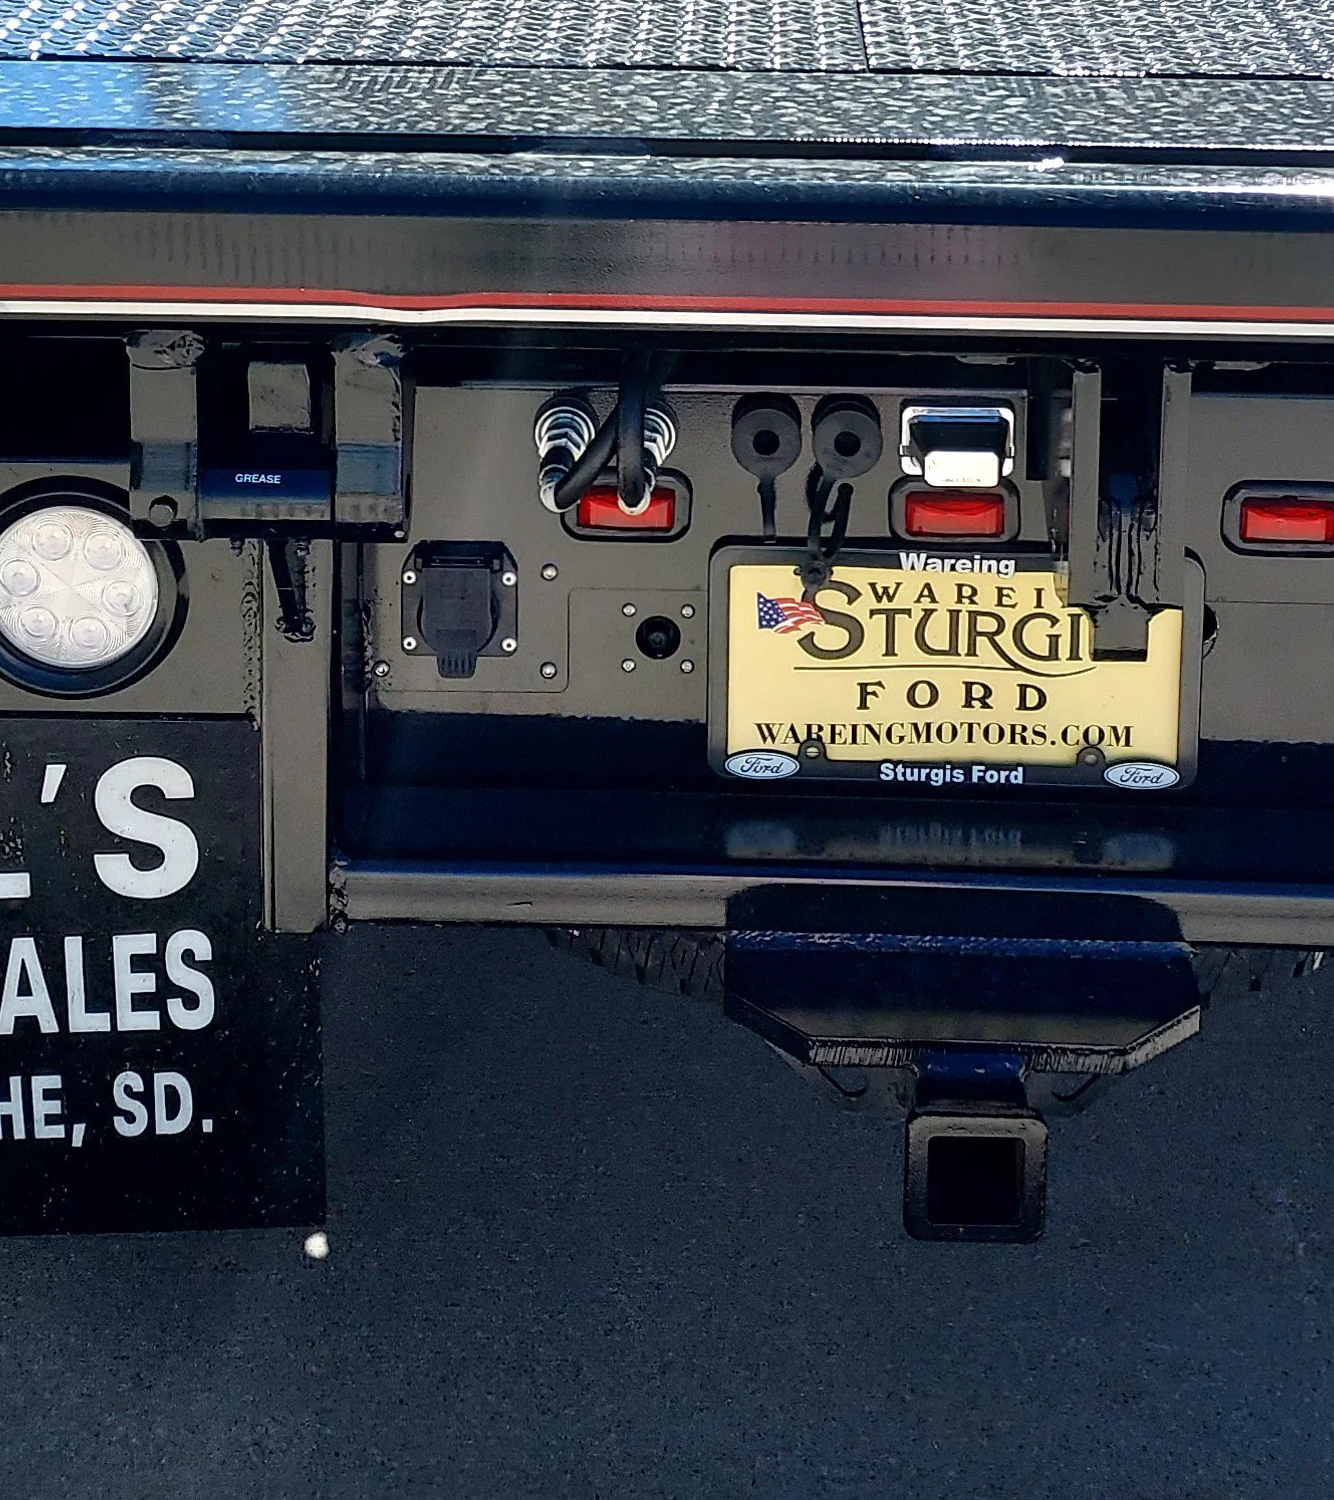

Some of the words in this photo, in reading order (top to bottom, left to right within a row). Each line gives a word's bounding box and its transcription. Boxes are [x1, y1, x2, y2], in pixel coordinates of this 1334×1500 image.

[235, 473, 282, 484] GREASE
[899, 552, 1016, 578] Wareing
[867, 581, 1067, 609] WAREI
[797, 580, 1087, 677] STURGI
[856, 679, 1048, 712] FORD
[754, 721, 1134, 748] WAREINGMOTORS.COM
[740, 756, 783, 775] Ford
[879, 762, 965, 786] Sturgis
[971, 765, 1024, 785] Ford
[1120, 766, 1164, 784] Ford
[113, 1071, 214, 1138] SD.
